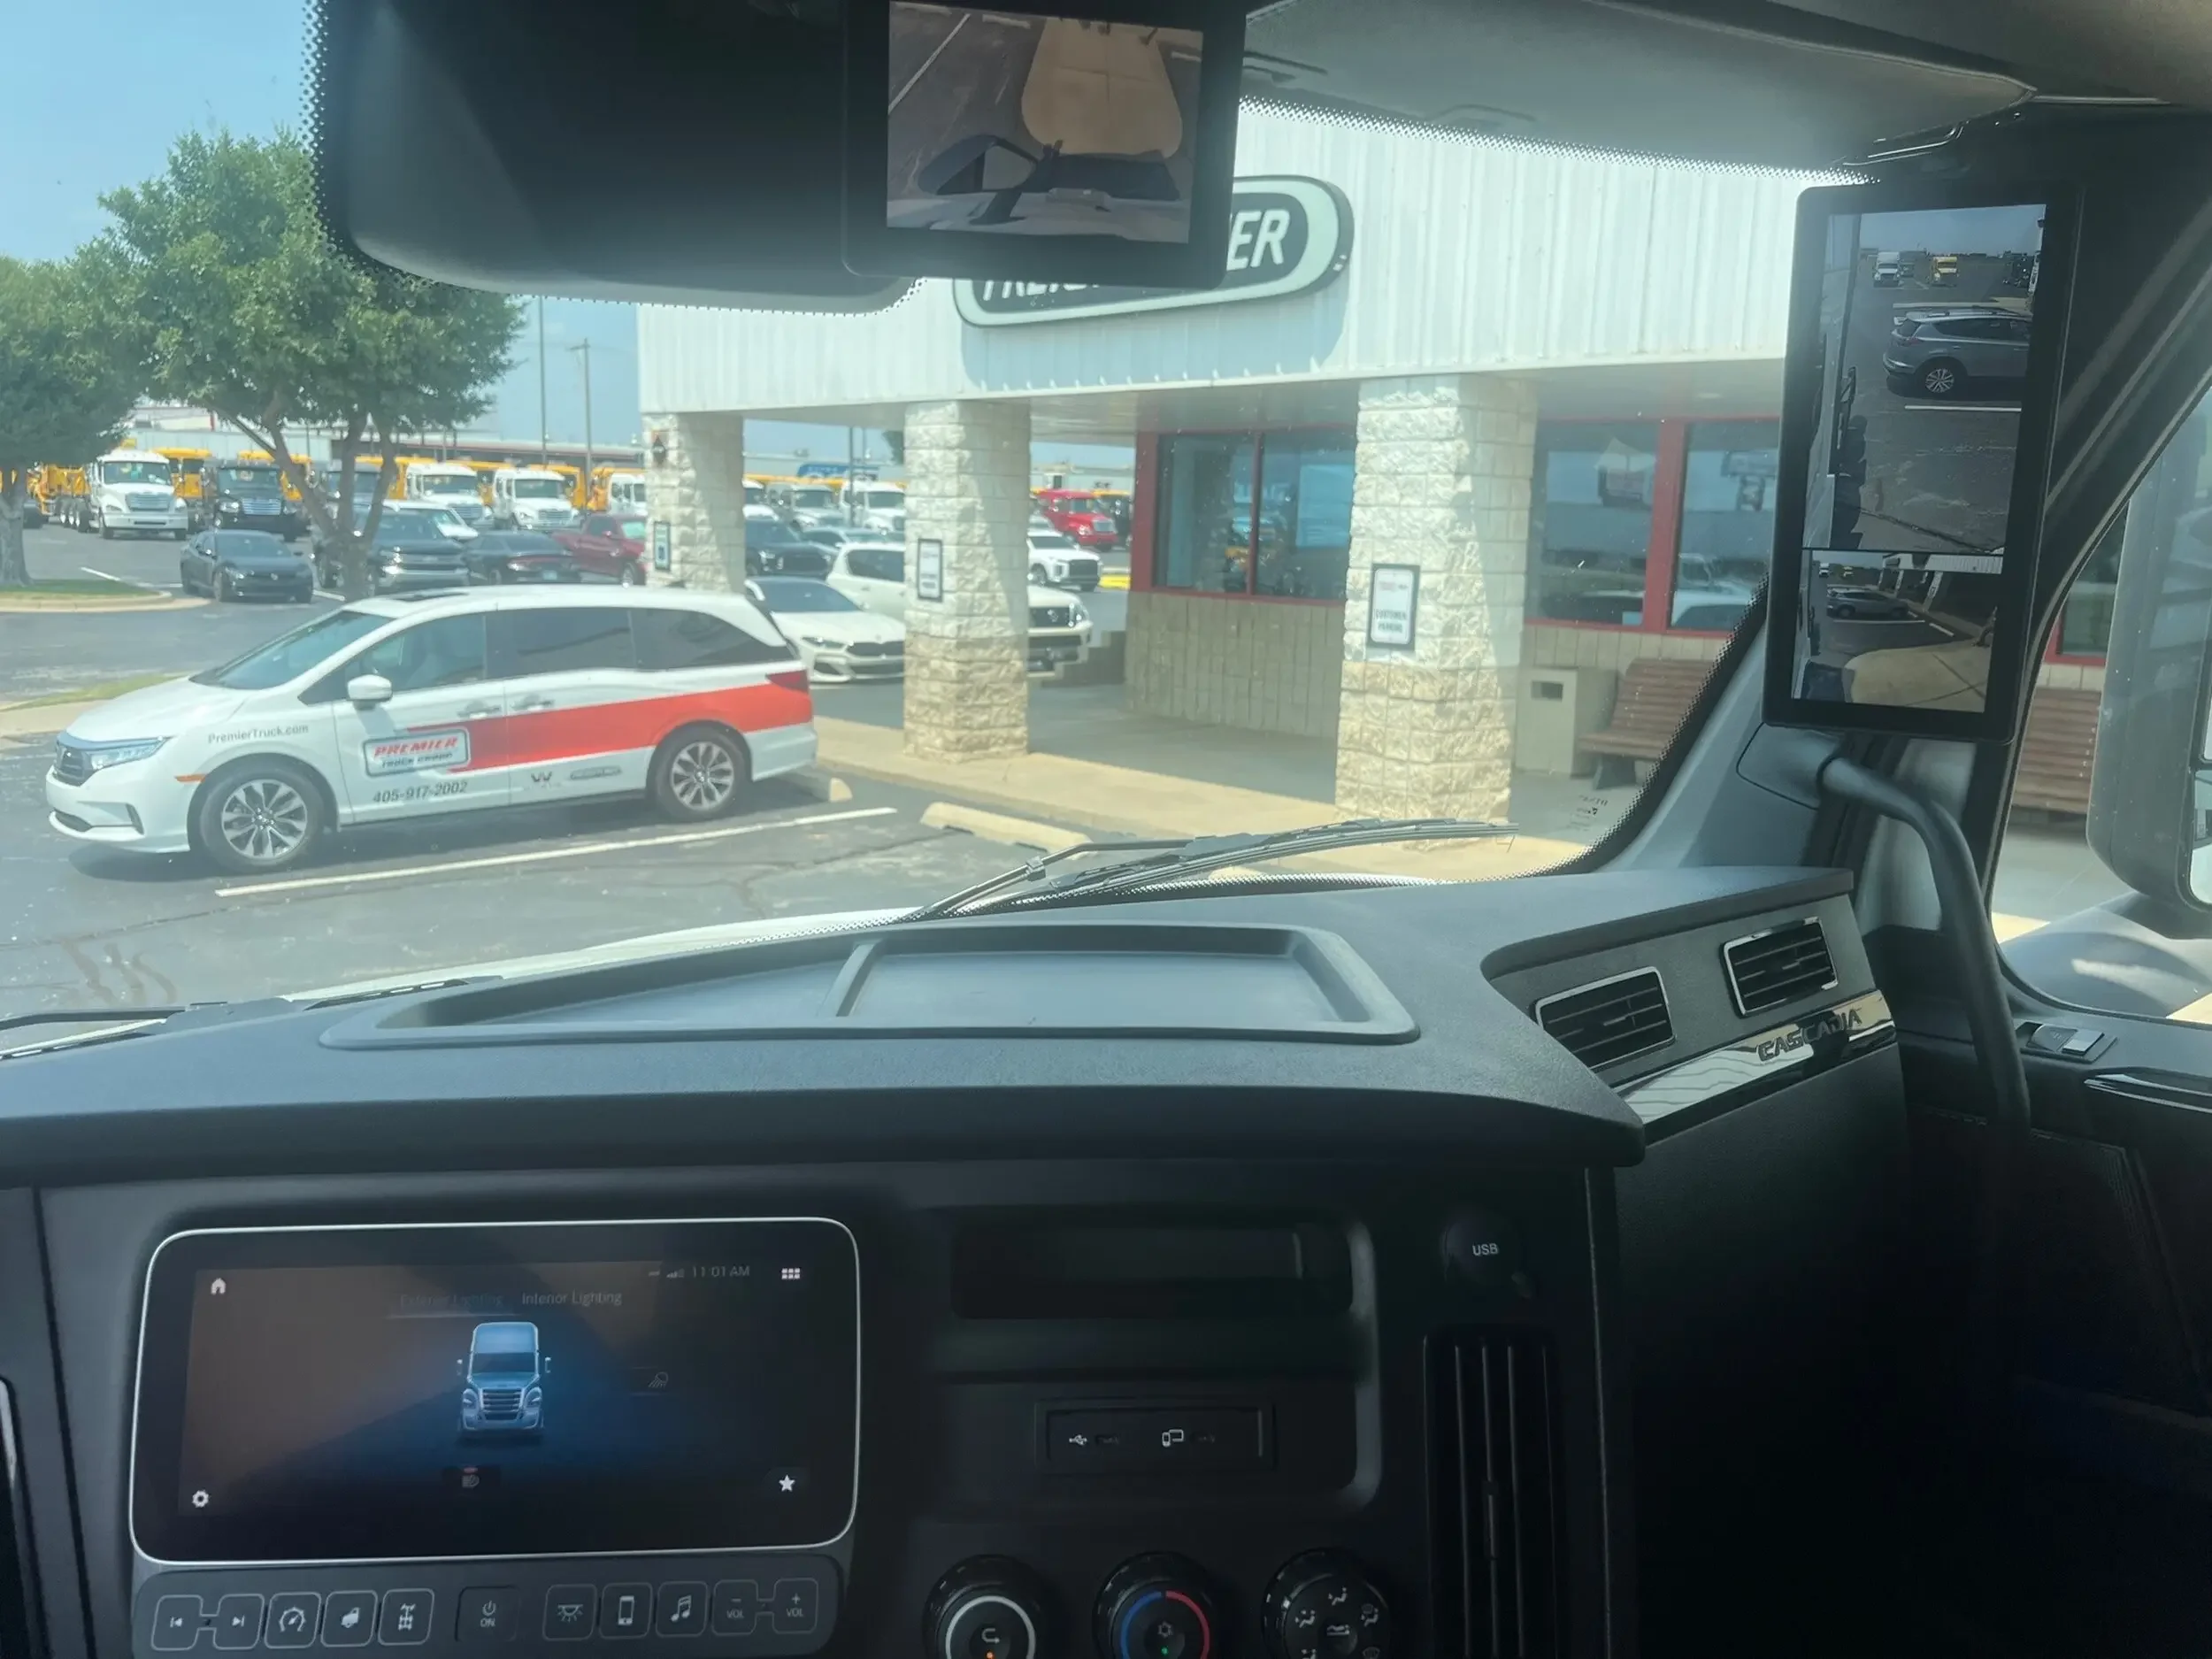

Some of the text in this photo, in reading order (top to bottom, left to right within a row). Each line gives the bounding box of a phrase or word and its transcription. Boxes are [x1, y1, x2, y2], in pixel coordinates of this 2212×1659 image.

[208, 724, 310, 744] PremierTruck.com
[373, 736, 458, 757] PREMIER
[373, 781, 468, 803] 405-917-2002
[1757, 1007, 1863, 1062] CASCADIA
[1472, 1242, 1499, 1256] USB
[693, 1265, 750, 1278] 11:01 AM
[521, 1289, 623, 1307] Interior Lighting
[726, 1609, 744, 1620] VOL
[785, 1608, 804, 1618] VOL
[480, 1617, 496, 1628] ON
